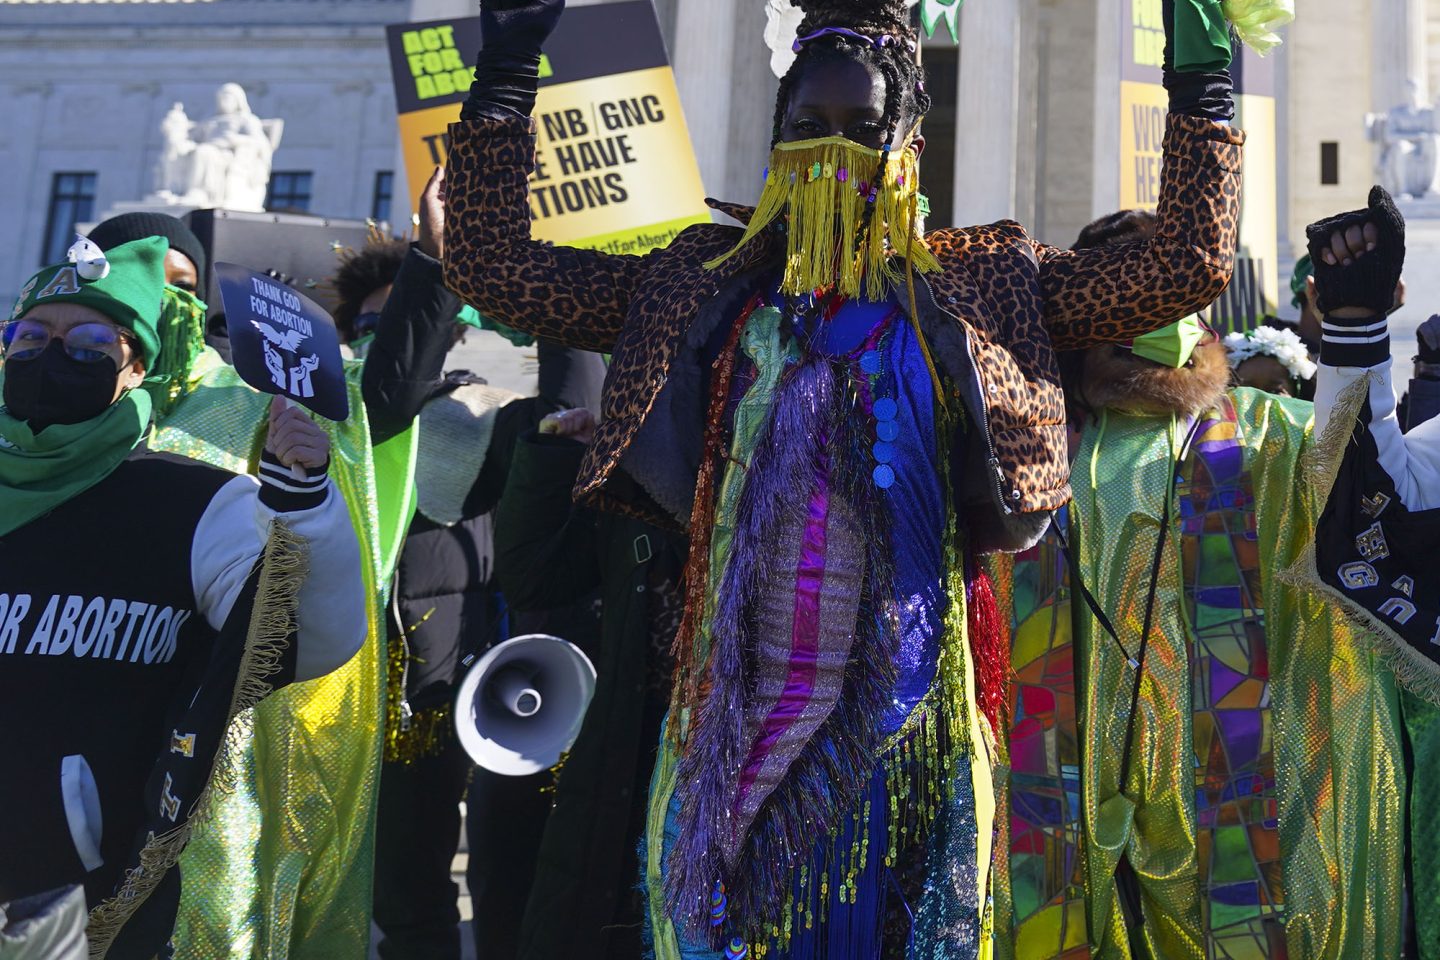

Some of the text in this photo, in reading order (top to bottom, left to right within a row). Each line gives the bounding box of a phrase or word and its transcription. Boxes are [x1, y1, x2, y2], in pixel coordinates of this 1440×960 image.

[408, 48, 465, 77] FOR
[542, 94, 666, 142] NB GNC
[554, 134, 637, 177] HAVE
[530, 172, 629, 221] TIONS
[249, 294, 313, 338] FOR ABORTION
[251, 276, 301, 313] THANK GOD
